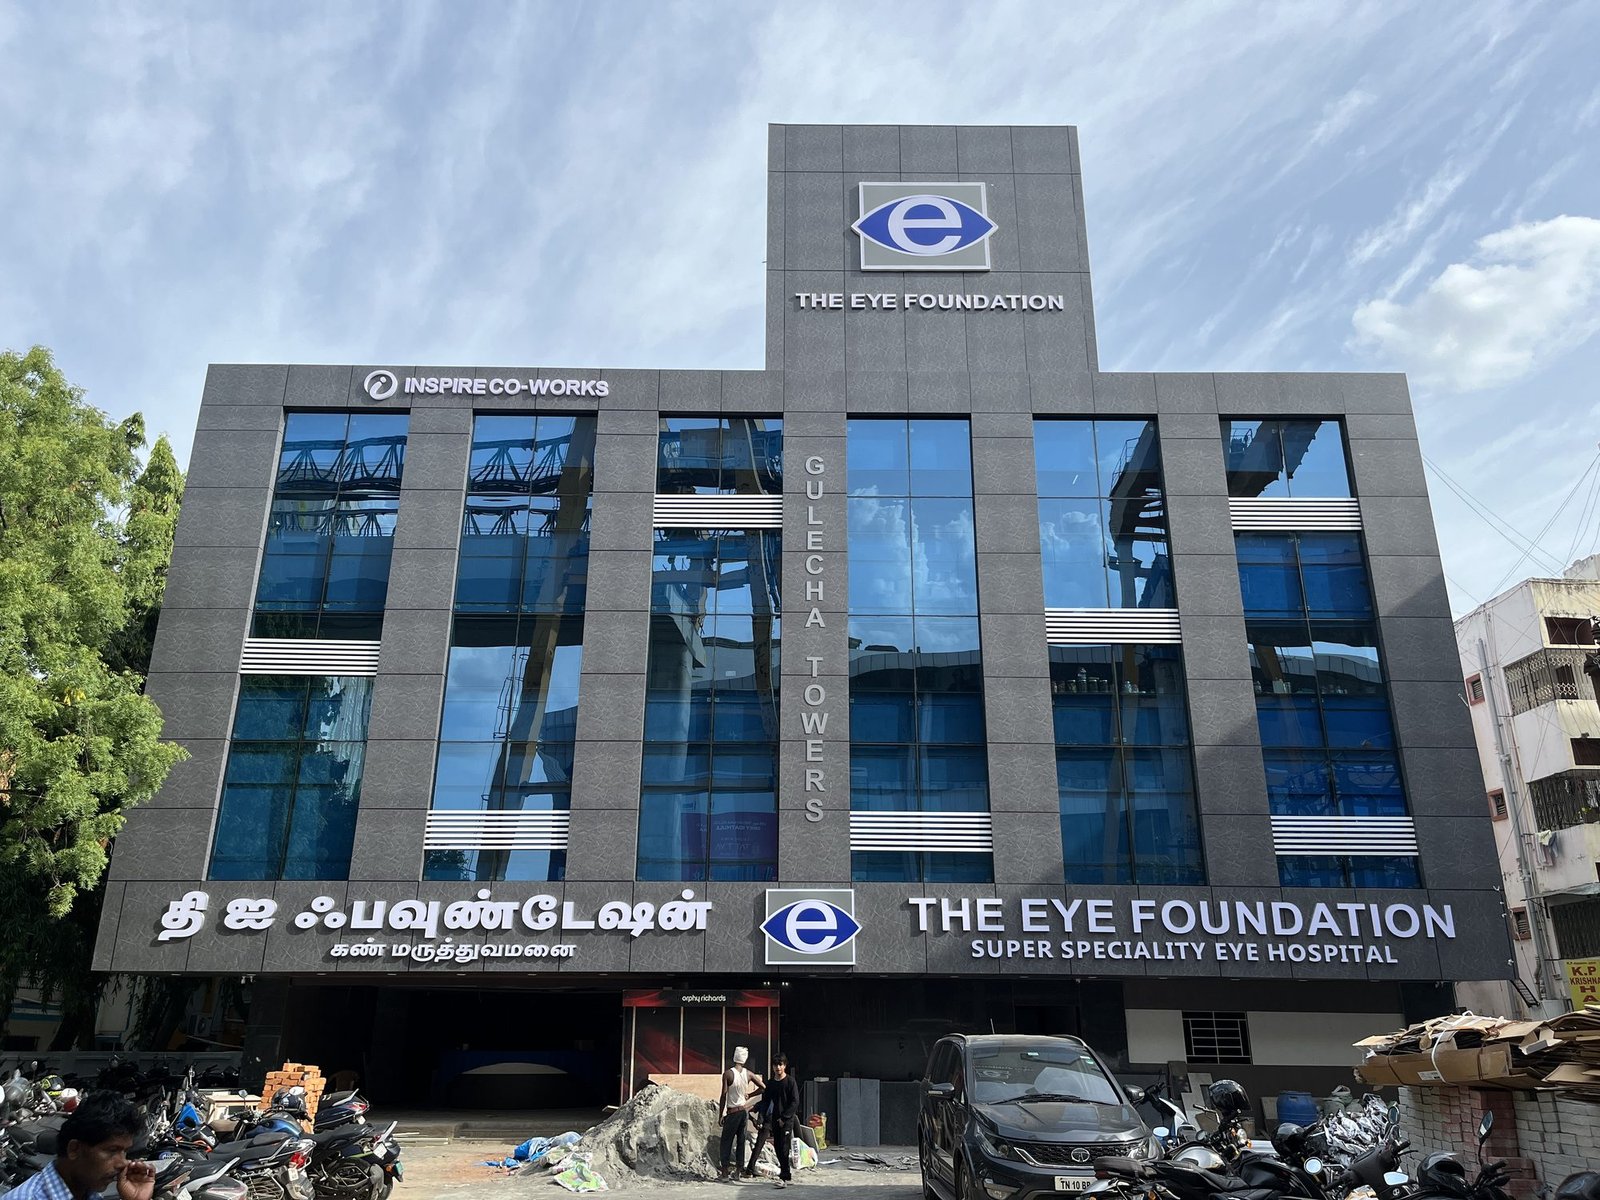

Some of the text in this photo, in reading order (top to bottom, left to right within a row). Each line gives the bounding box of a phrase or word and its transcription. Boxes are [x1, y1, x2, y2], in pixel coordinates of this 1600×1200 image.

[796, 292, 1064, 310] THE EYE FOUNDATION
[404, 376, 610, 397] INSPIRE CO-WORKS
[800, 455, 829, 822] GULECHA TOWERS
[158, 888, 713, 941] தி ஐ ஃபவுண்டேஷன்
[908, 897, 1456, 939] THE EYE FOUNDATION
[330, 937, 578, 963] கண் மருத்துவமனை
[971, 940, 1399, 964] SUPER SPECIALITY EYE HOSPITAL
[700, 994, 726, 1002] richards
[1060, 1181, 1070, 1190] TN
[1072, 1181, 1080, 1190] 10
